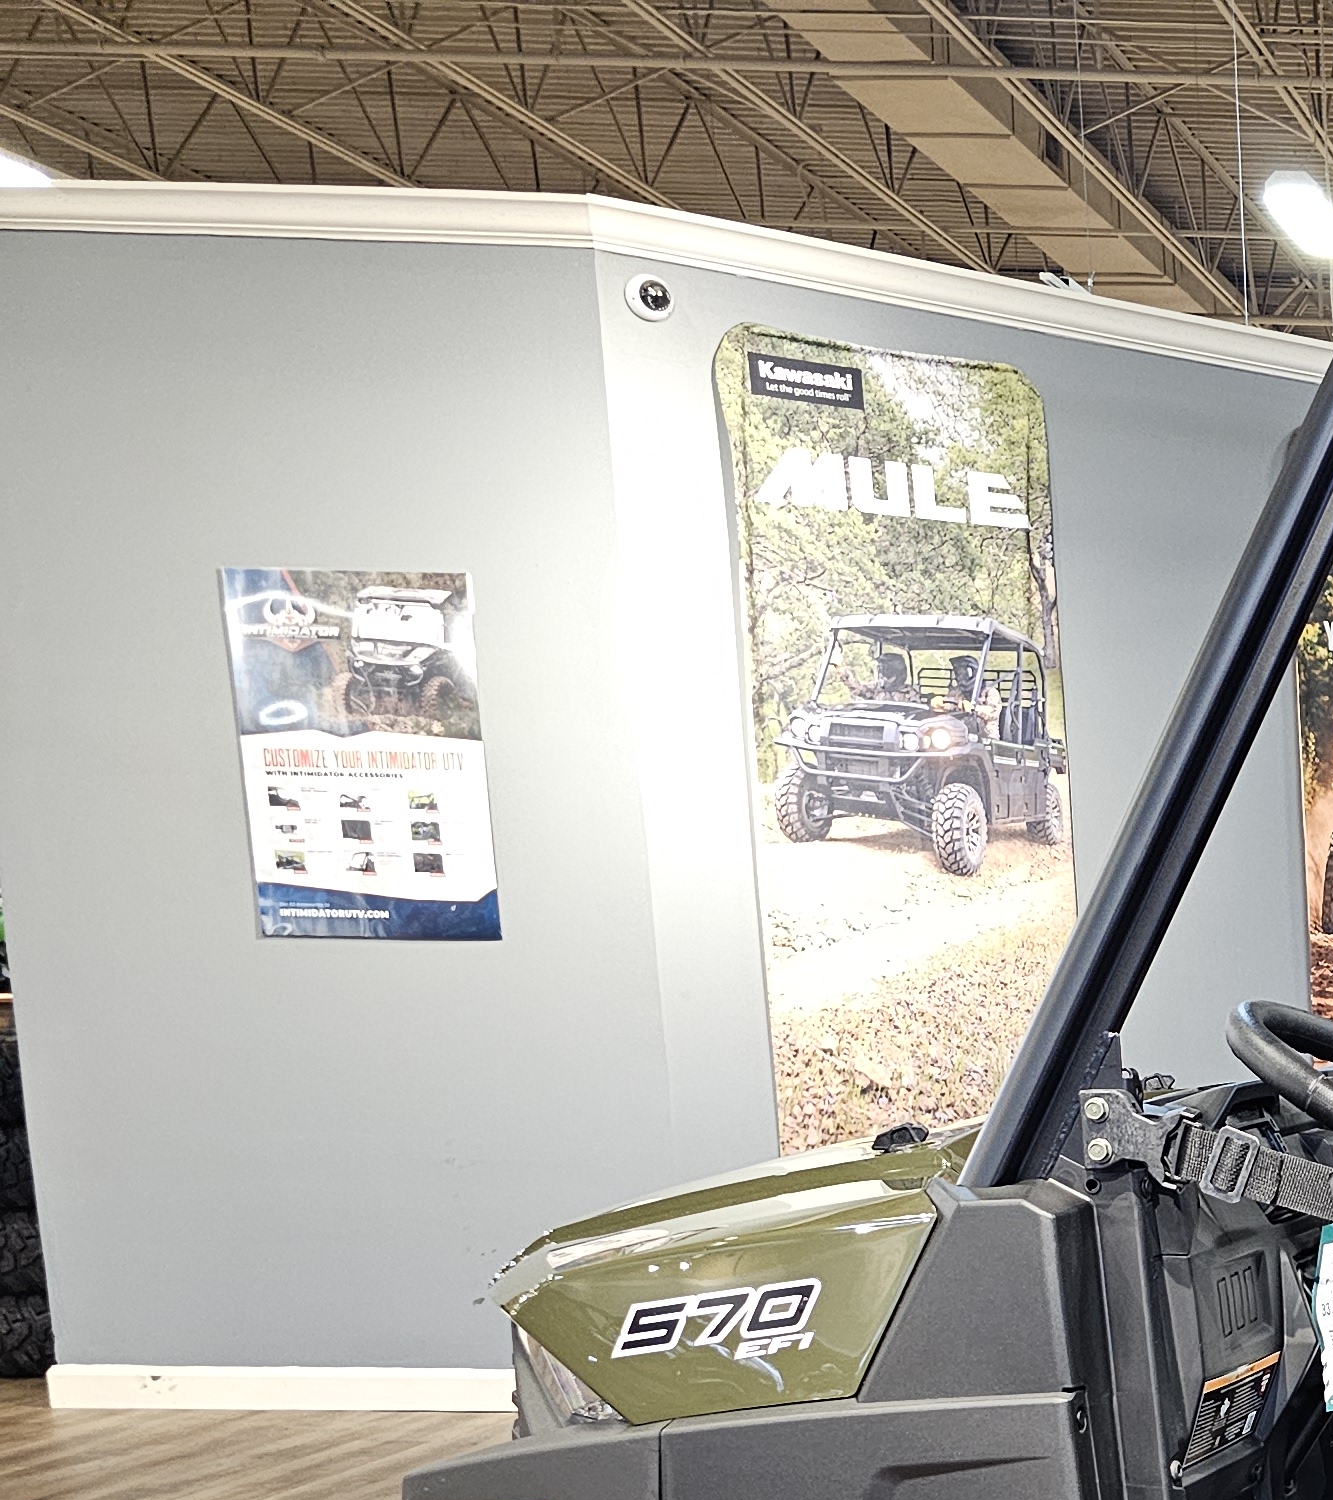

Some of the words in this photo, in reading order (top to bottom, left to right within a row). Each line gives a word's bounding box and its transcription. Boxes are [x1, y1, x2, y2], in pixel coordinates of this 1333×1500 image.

[757, 359, 853, 391] Kawasaki
[765, 382, 779, 392] Let
[779, 384, 793, 394] the
[793, 387, 814, 397] good
[815, 389, 835, 400] times
[754, 446, 1034, 530] MULE
[263, 748, 328, 768] CUSTOMIZE
[334, 750, 363, 769] YOUR
[367, 751, 437, 770] INTIMIDATOR
[442, 753, 464, 771] UTV
[280, 908, 390, 919] INTIMIDATORUTV.COM
[611, 1277, 822, 1359] 570
[734, 1331, 816, 1360] EFI
